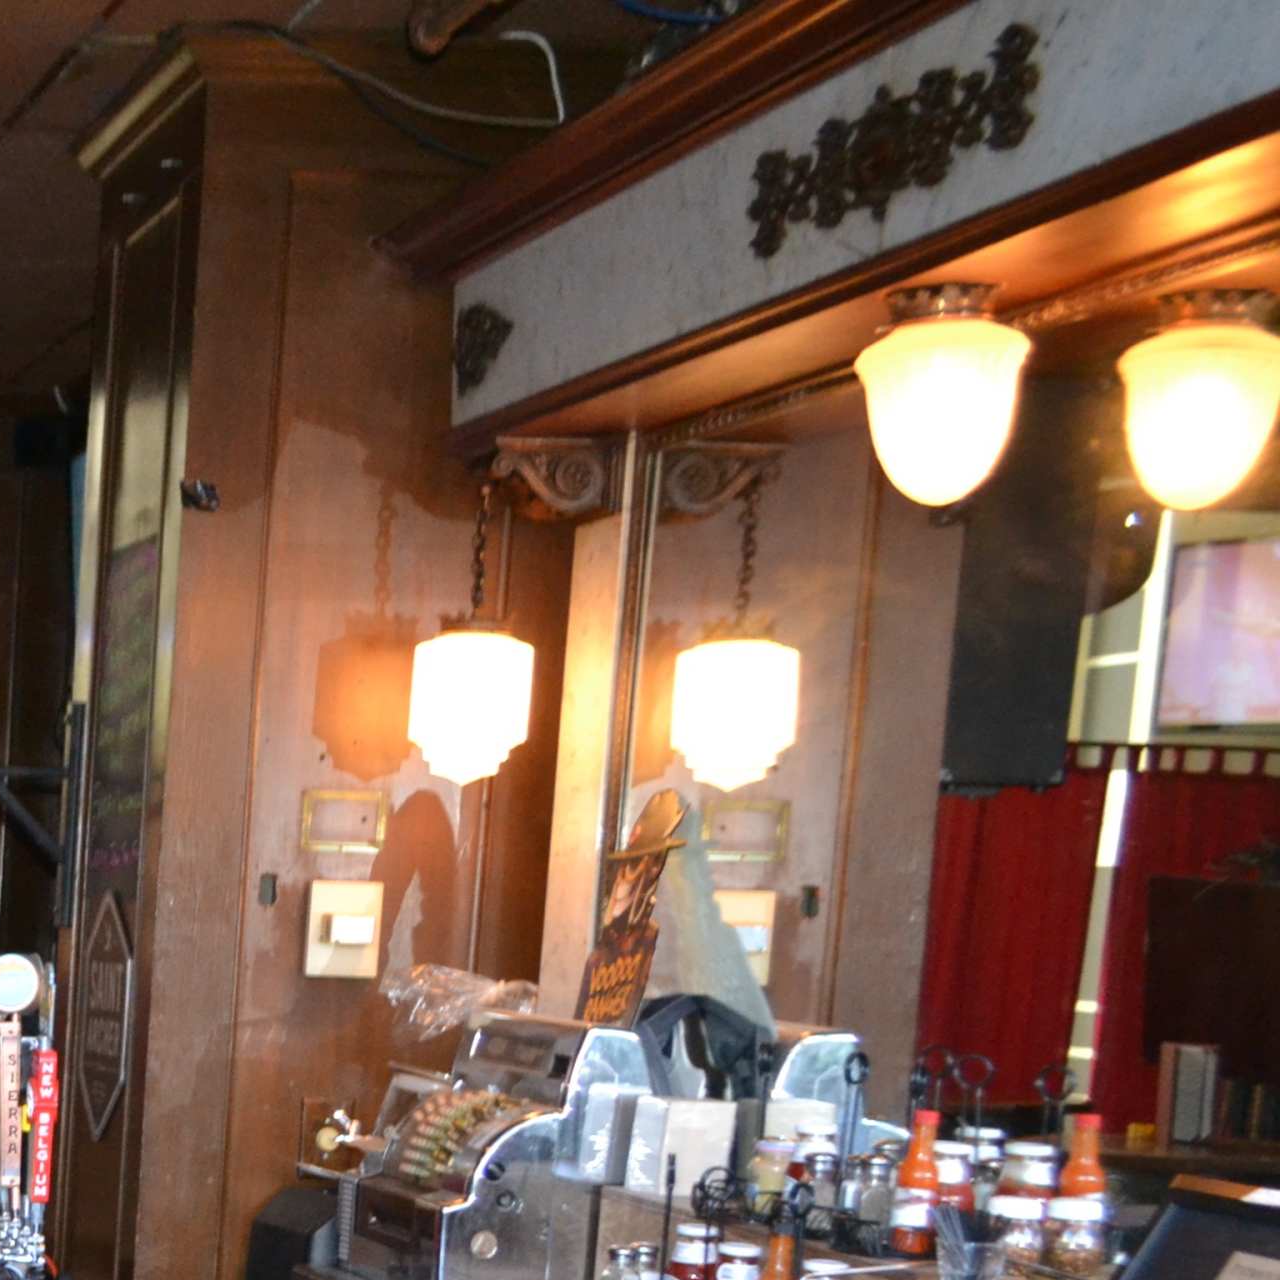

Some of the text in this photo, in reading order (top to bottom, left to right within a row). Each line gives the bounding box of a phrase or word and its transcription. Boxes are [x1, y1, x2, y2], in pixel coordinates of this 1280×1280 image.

[7, 1054, 18, 1154] SIERRA
[34, 1063, 54, 1196] NEW BELGIUM
